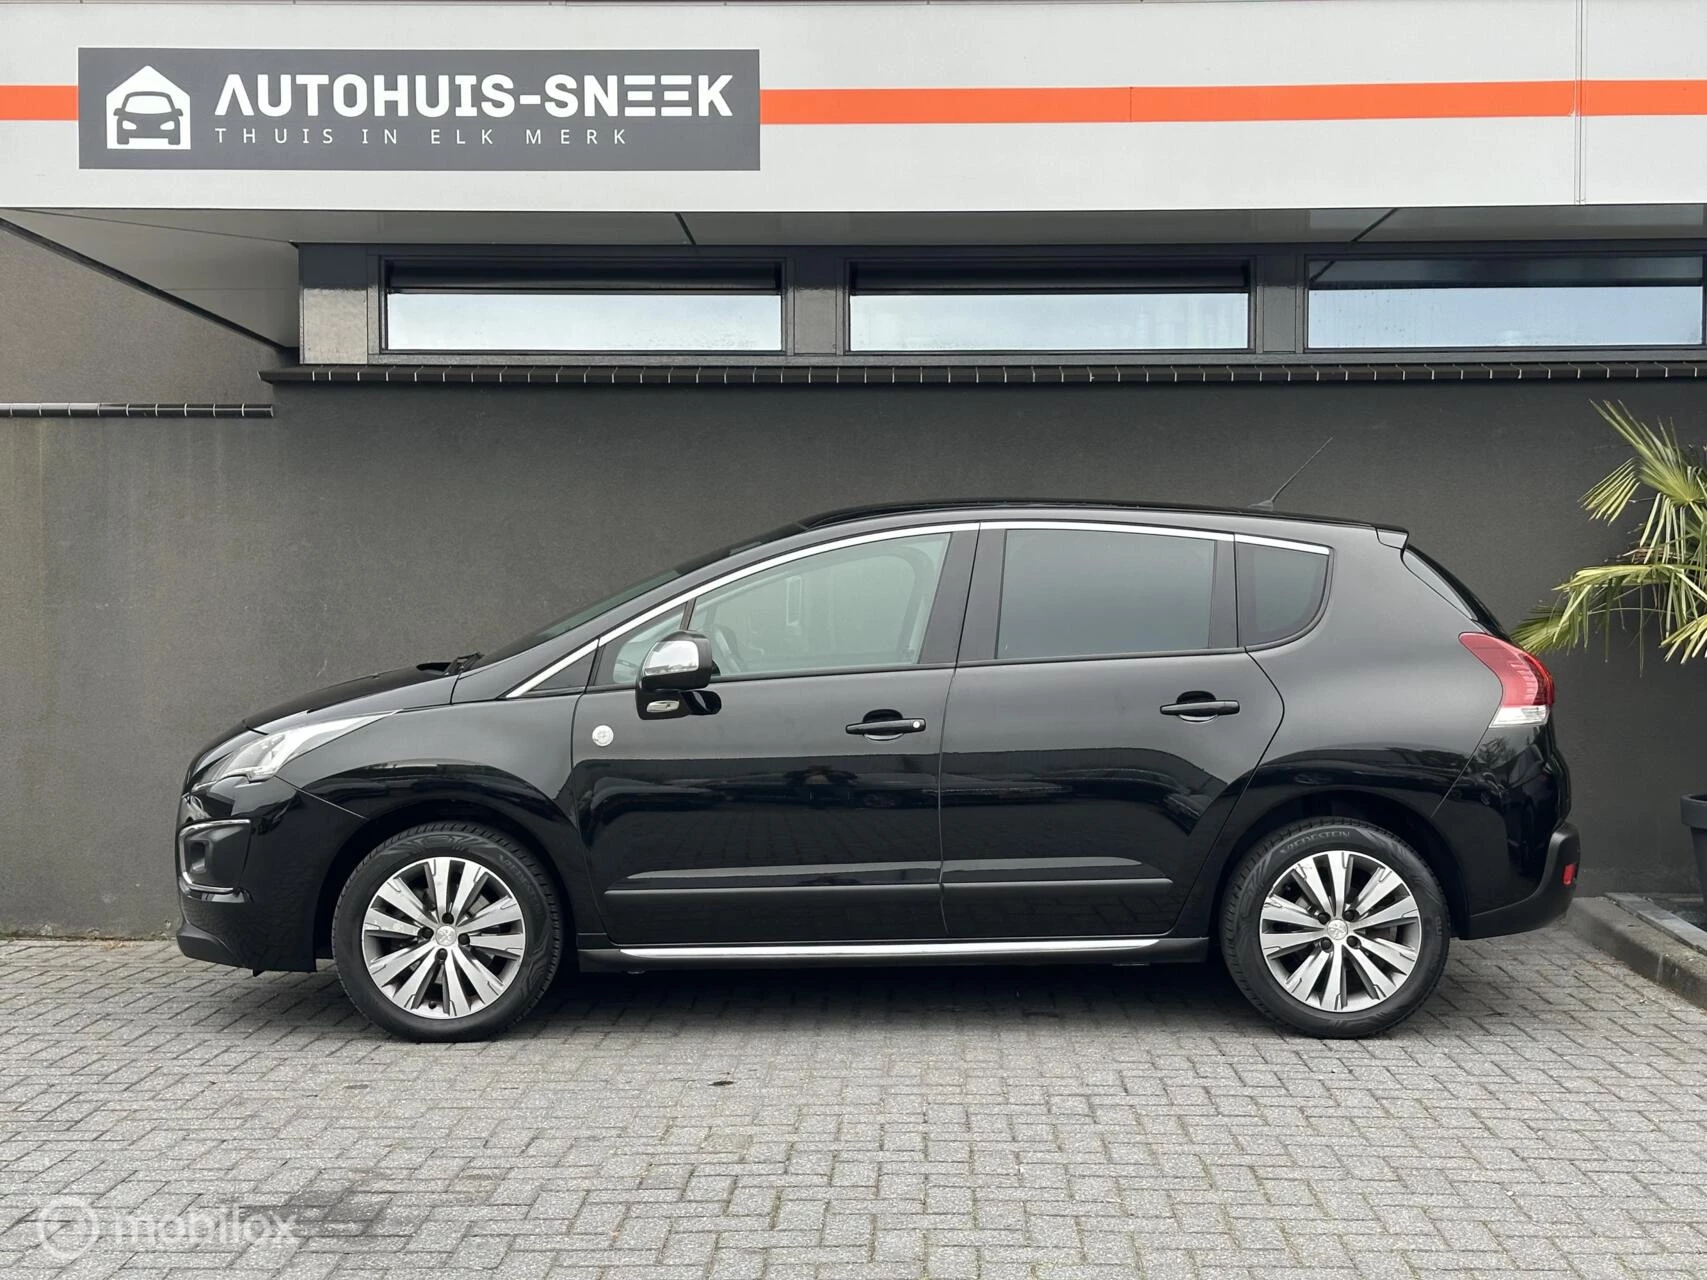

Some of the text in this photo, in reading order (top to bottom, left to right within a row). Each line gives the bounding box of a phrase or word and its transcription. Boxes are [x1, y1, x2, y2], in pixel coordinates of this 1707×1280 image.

[214, 73, 734, 119] AUTOHUIS-SNEEK
[214, 127, 627, 145] THUIS IN ELK MERK
